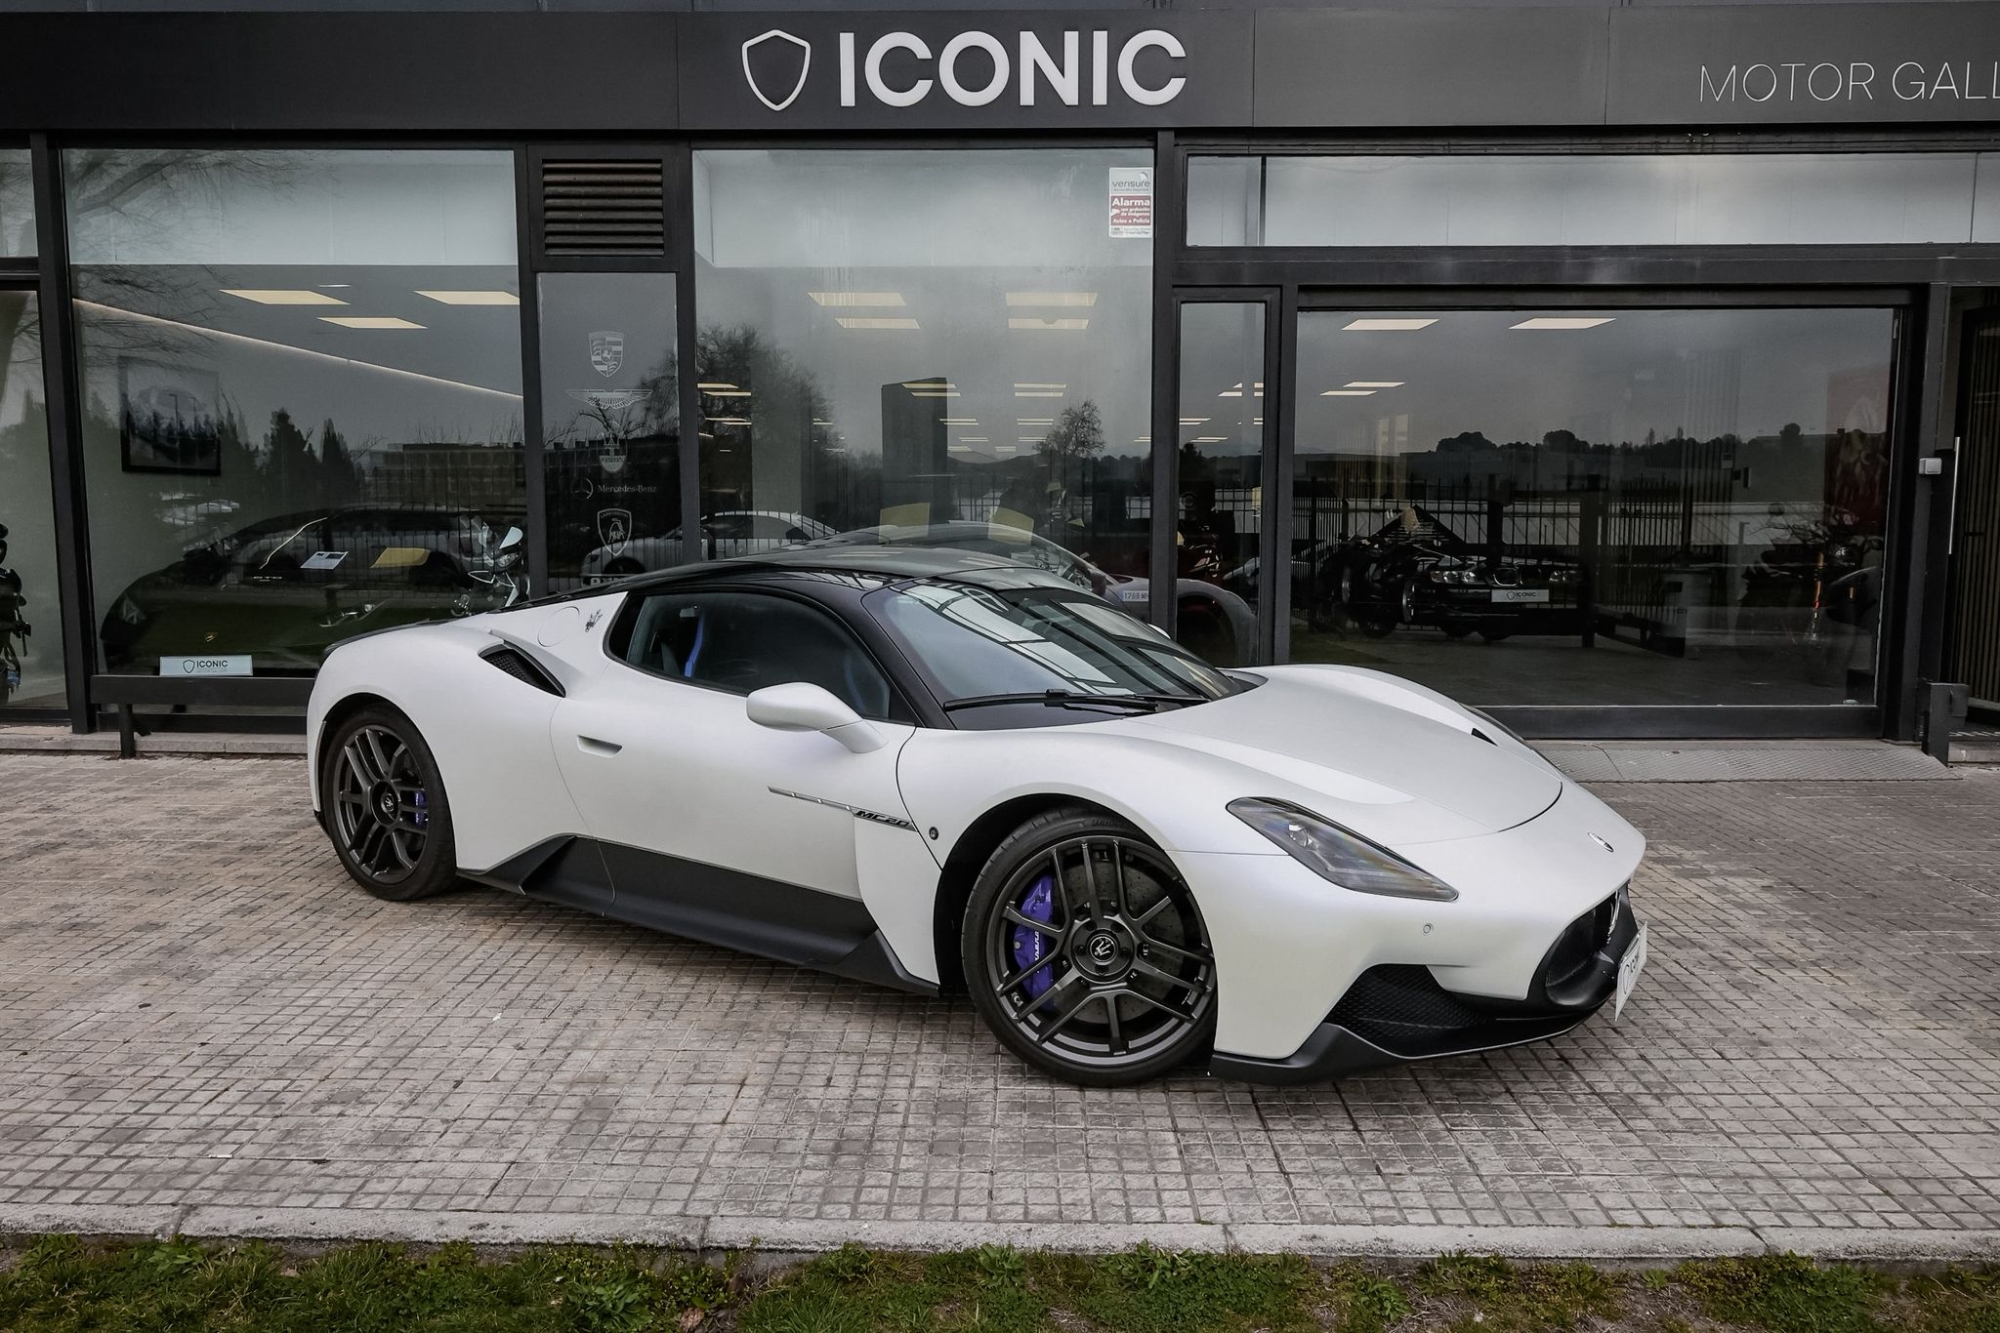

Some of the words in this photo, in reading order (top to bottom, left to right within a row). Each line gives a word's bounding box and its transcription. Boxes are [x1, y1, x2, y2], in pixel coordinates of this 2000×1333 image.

[839, 30, 1187, 107] ICONIC
[1699, 62, 1875, 102] MOTOR
[1112, 180, 1151, 188] verisure
[1112, 197, 1150, 206] Alarma
[597, 484, 657, 493] Mercedes-Benz
[196, 659, 229, 668] ICONIC
[856, 810, 910, 828] MC20
